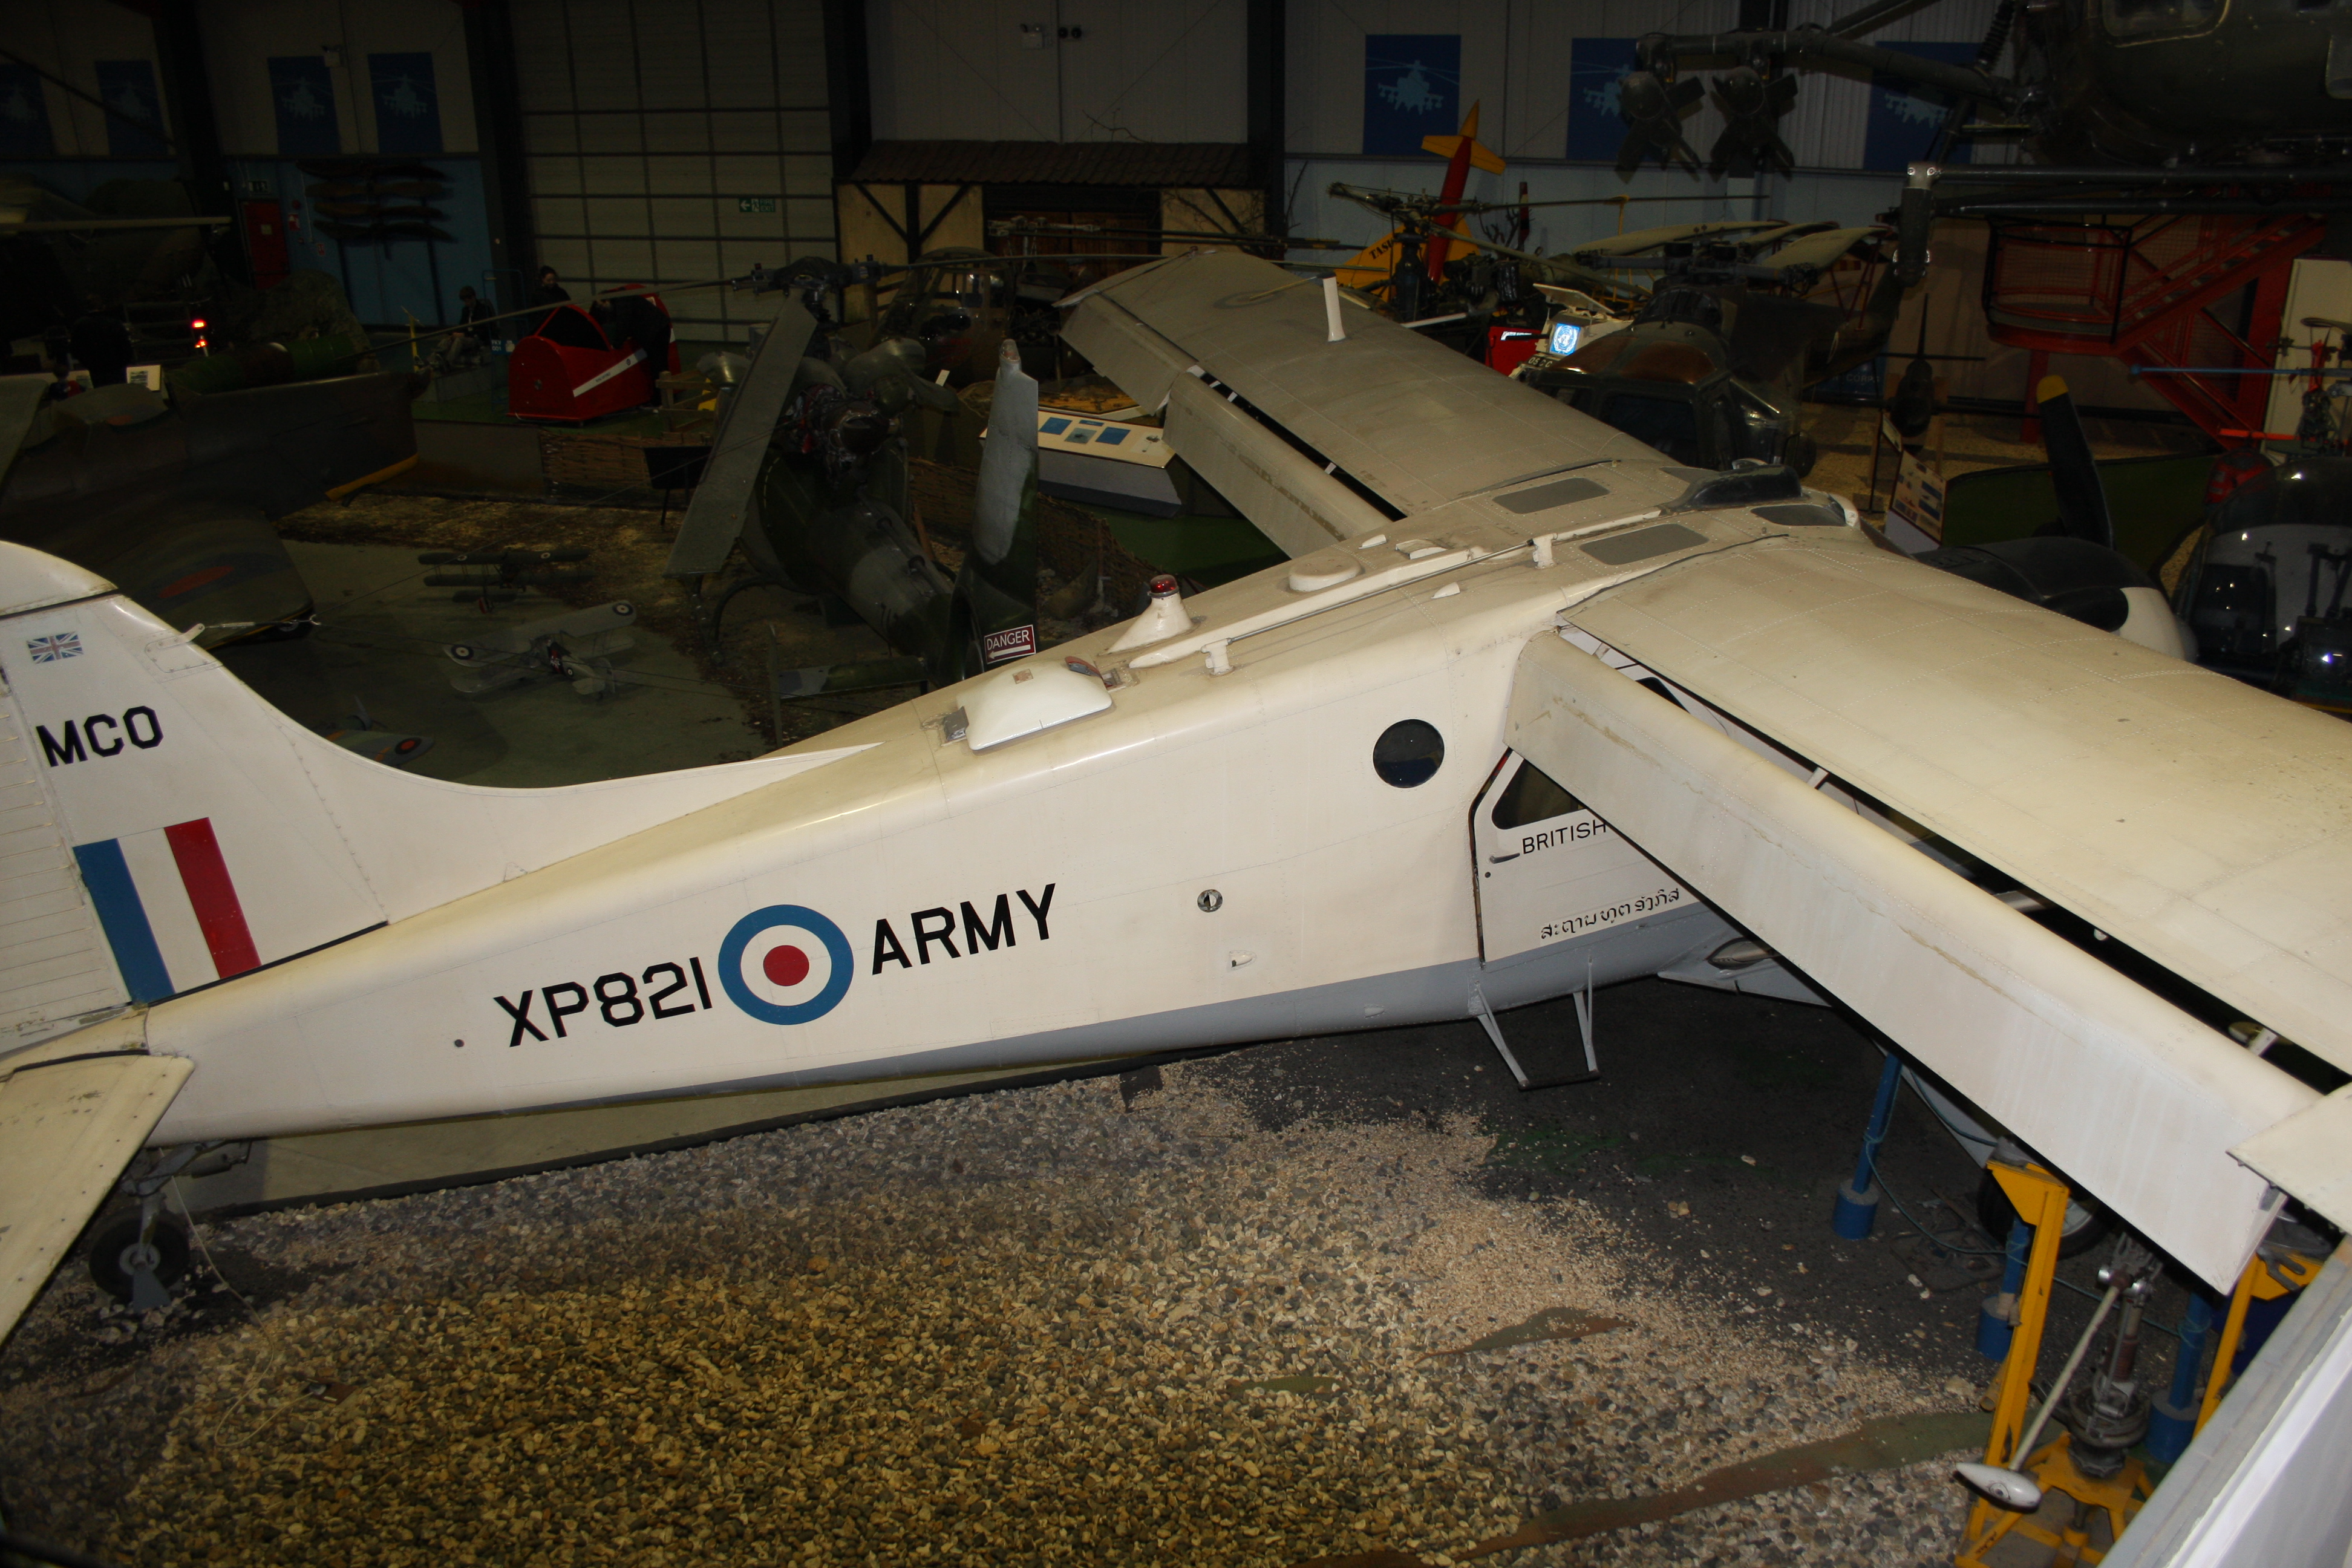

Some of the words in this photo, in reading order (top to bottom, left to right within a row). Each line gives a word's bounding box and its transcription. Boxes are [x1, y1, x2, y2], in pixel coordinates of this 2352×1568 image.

[987, 630, 1030, 650] DANGER
[35, 706, 163, 767] MCO
[1522, 819, 1606, 854] BRITISH
[873, 884, 1055, 975] ARMY
[494, 957, 711, 1047] XP821
